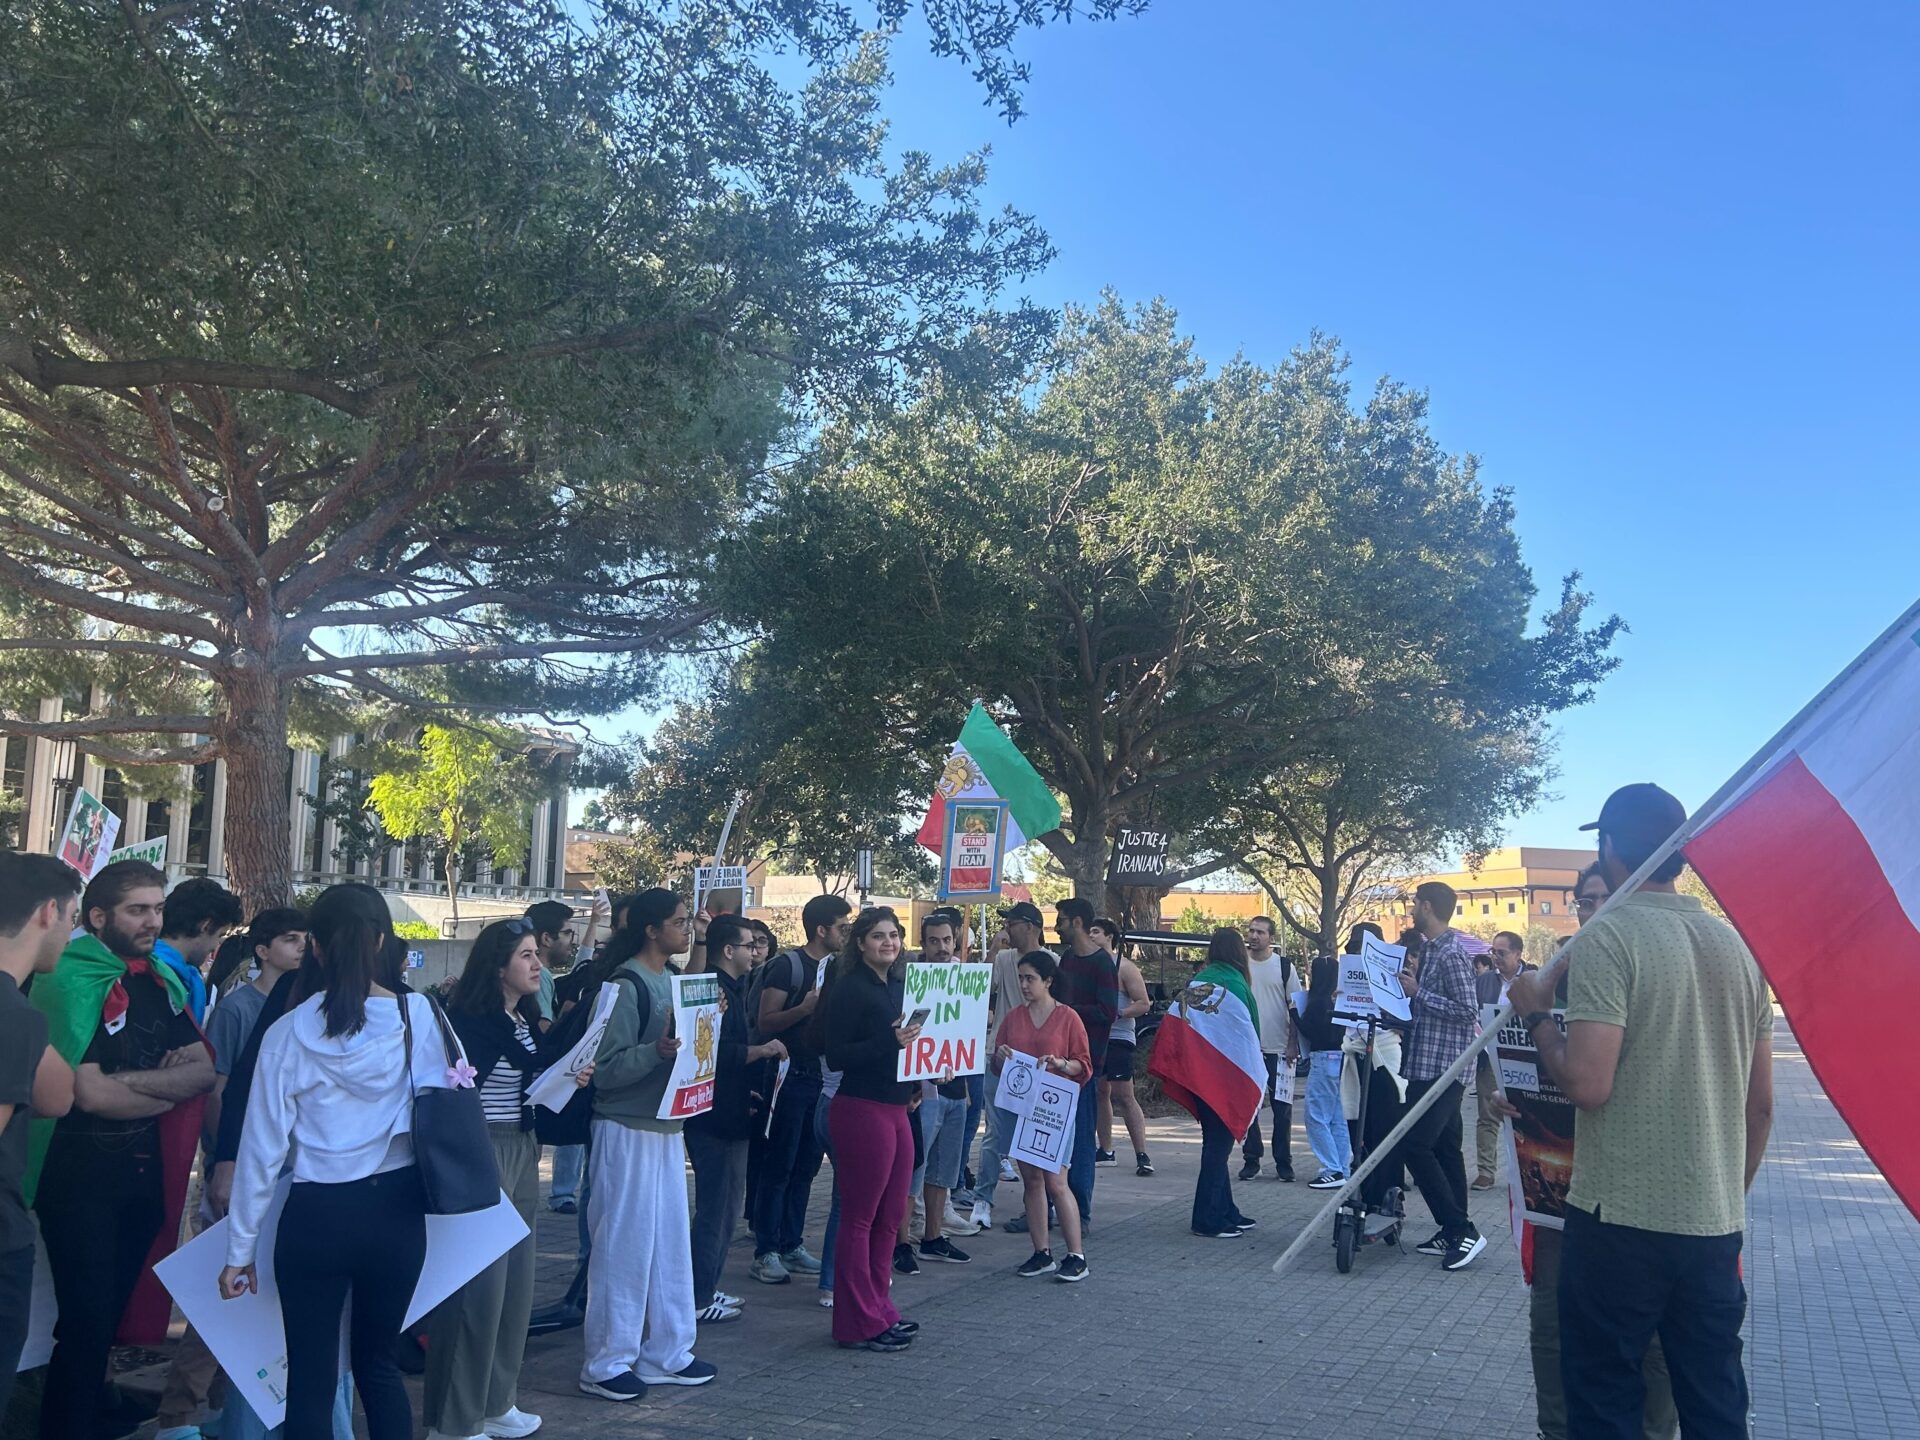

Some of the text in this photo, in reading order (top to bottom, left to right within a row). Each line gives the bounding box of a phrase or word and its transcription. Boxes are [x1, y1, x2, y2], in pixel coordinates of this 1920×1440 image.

[963, 838, 985, 846] STAND
[1118, 829, 1168, 852] JUSTICE 4
[960, 855, 984, 866] IRAN
[1117, 853, 1167, 876] IRANIANS
[723, 867, 742, 878] IRAN
[722, 878, 742, 887] AGAIN
[906, 963, 989, 1004] Regime Change
[935, 999, 961, 1024] IN
[904, 1037, 976, 1077] IRAN
[1522, 1091, 1539, 1100] THIS
